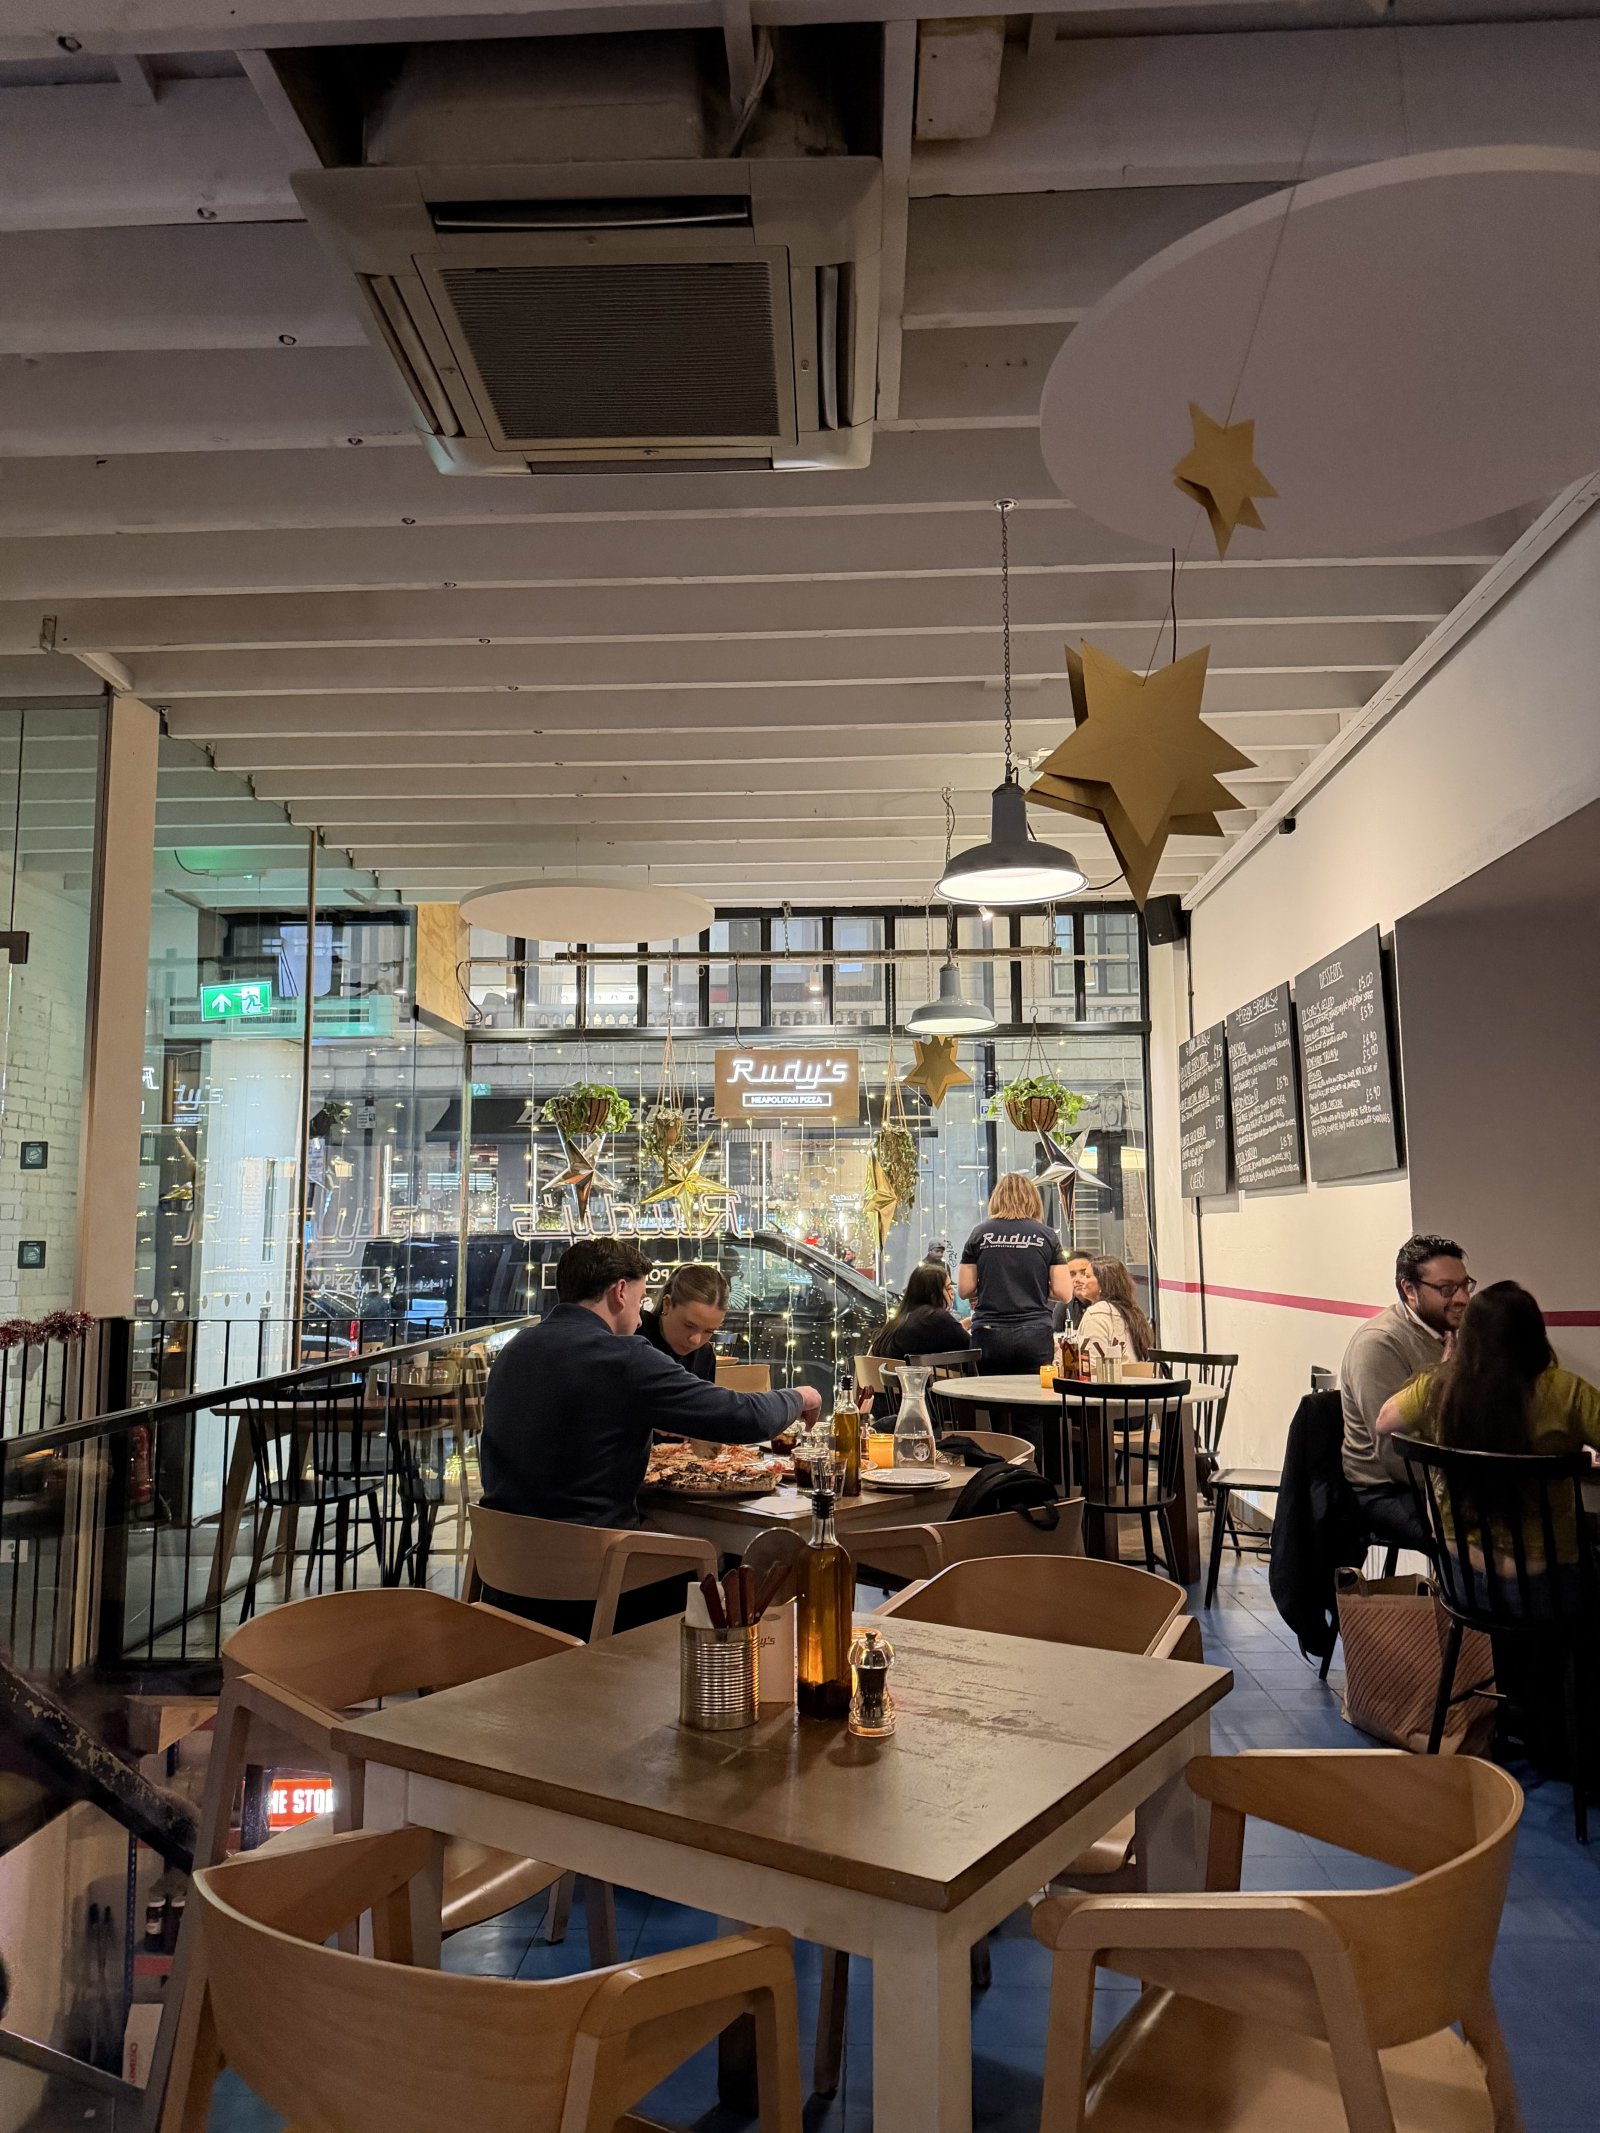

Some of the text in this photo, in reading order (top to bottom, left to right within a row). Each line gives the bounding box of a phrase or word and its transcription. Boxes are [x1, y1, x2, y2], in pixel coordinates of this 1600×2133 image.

[727, 1060, 848, 1089] Rudy's
[751, 1096, 822, 1104] NEAPOLITAN PIZZA
[980, 1232, 1044, 1249] Rudy's
